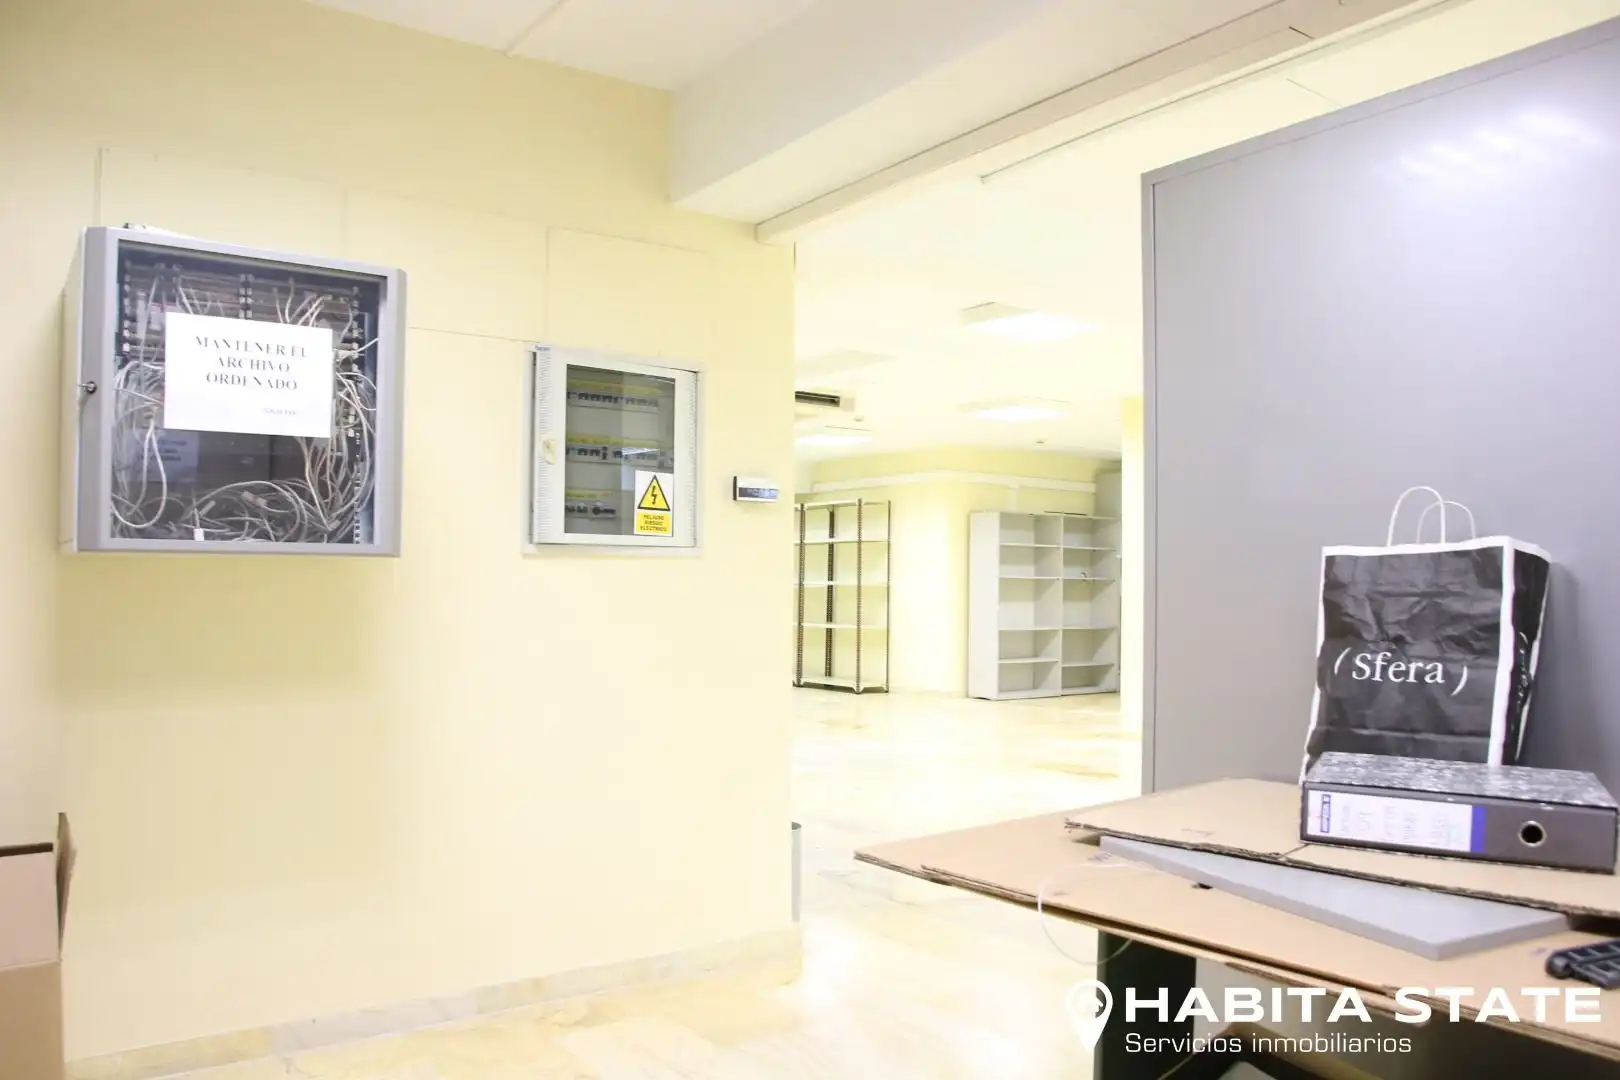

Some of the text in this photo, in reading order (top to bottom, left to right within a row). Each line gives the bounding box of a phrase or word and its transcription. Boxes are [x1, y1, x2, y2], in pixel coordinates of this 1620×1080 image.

[195, 335, 286, 356] MANTENER
[218, 356, 290, 373] ARCHIVO
[206, 371, 298, 391] ORDENADO
